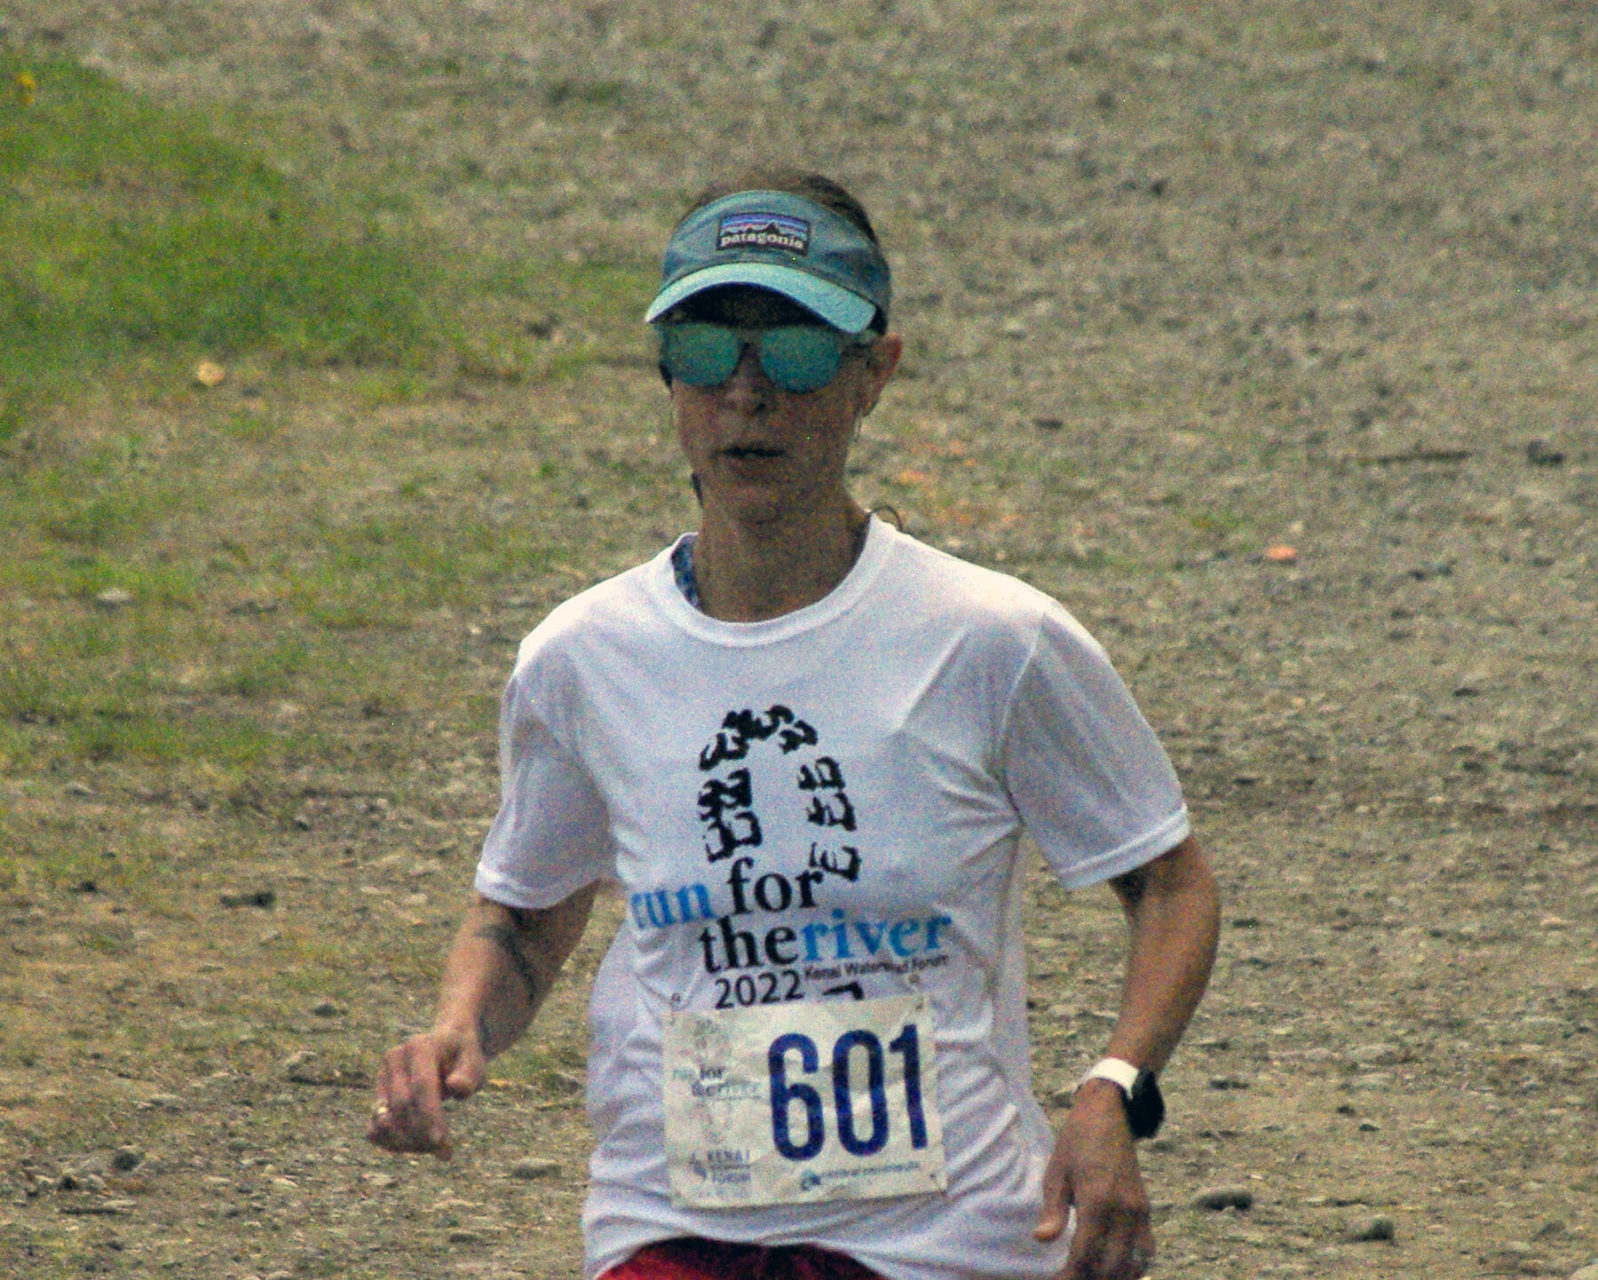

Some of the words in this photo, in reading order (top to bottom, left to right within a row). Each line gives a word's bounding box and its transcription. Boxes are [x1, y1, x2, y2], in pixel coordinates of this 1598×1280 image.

[721, 232, 804, 249] patagonia
[726, 856, 824, 916] for
[714, 969, 806, 1010] 2022
[768, 1023, 928, 1162] 601
